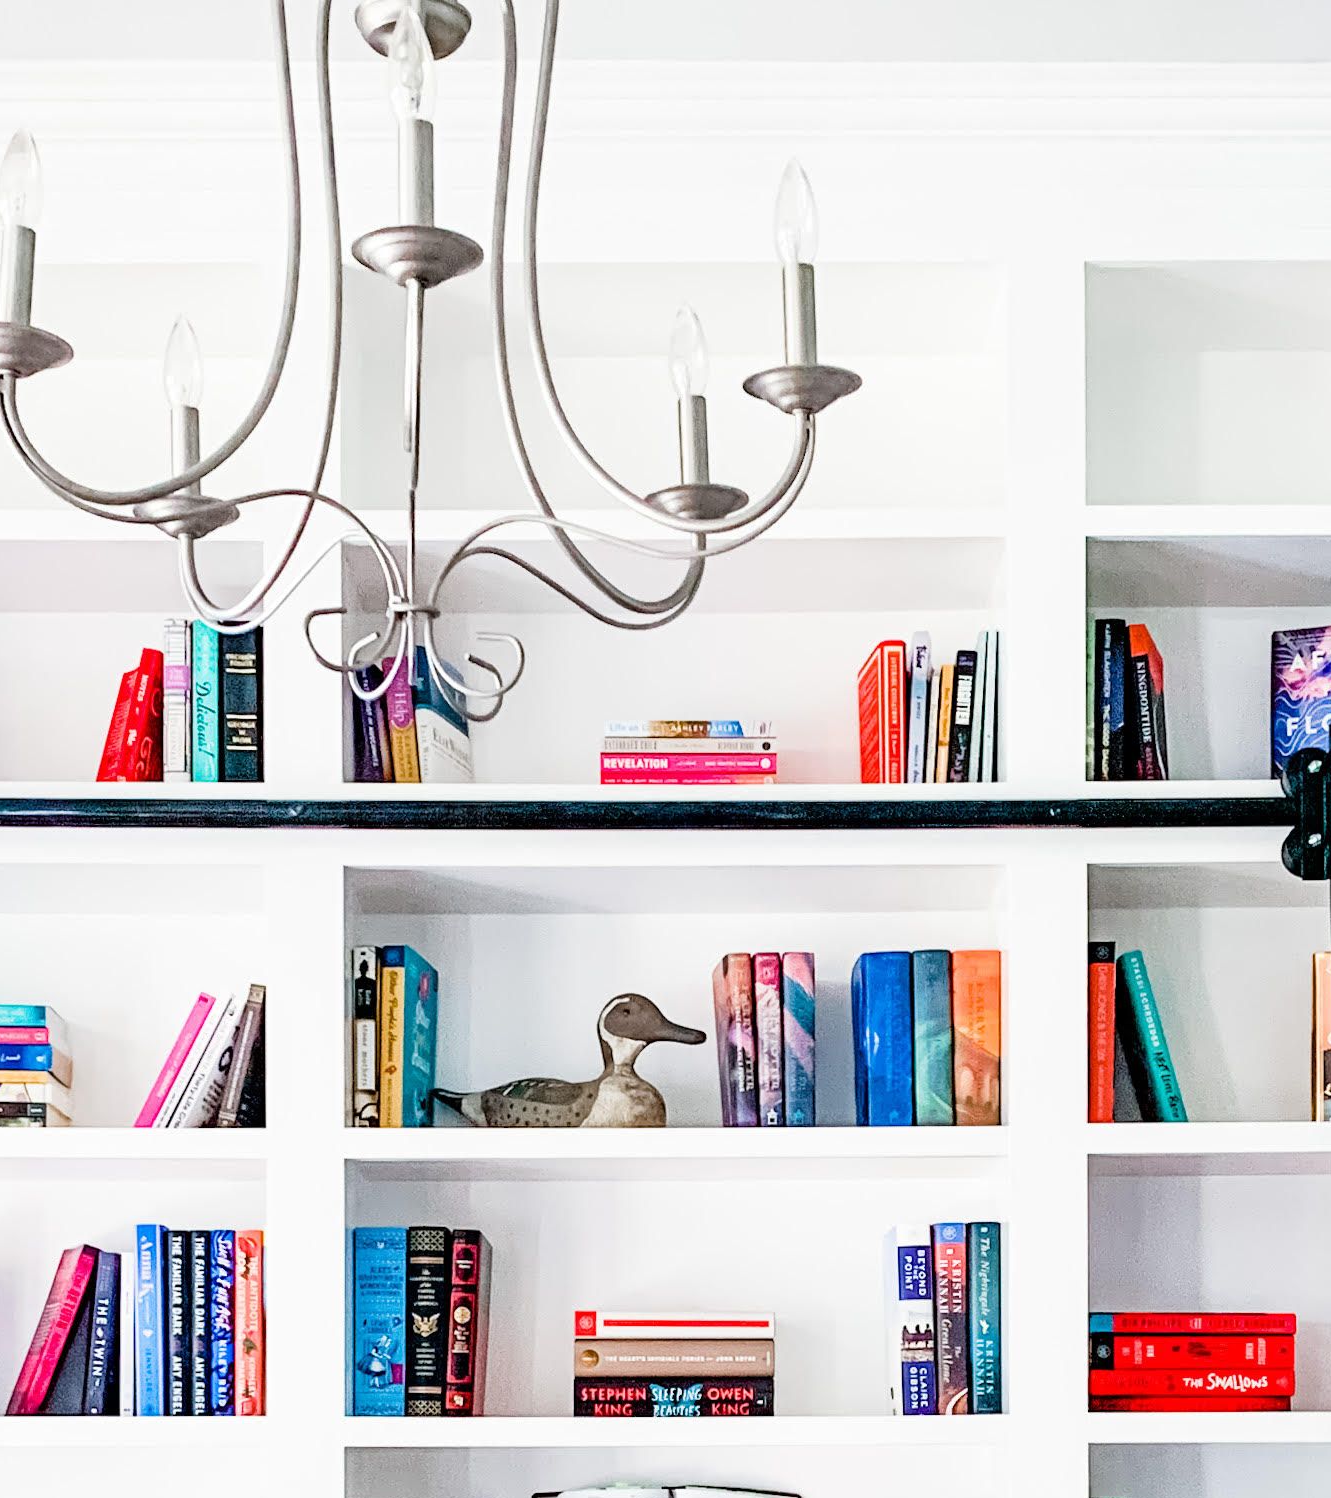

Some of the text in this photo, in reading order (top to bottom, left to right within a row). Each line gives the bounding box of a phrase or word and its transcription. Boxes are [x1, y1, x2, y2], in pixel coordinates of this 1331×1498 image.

[195, 681, 215, 756] Delicious!
[393, 693, 409, 722] Help
[1135, 662, 1152, 742] KINGDOMTIDE
[603, 757, 668, 769] REVELATION
[905, 1255, 915, 1290] POINT
[916, 1249, 927, 1296] BEYOND
[939, 1259, 949, 1314] HANNAH
[952, 1259, 962, 1313] KRISTIN
[979, 1238, 991, 1316] The Nightingale
[92, 1298, 109, 1377] THE TWIN
[193, 1236, 206, 1415] THE FAMILIAR DARK AMY ENGEL
[942, 1319, 953, 1383] Great Alone
[976, 1339, 986, 1397] HANNAH
[985, 1339, 994, 1394] KRISTIN
[580, 1387, 646, 1416] STEPHEN KING
[650, 1386, 702, 1416] SLEEPING BEAUTIES
[707, 1387, 754, 1416] OWEN KING
[909, 1367, 919, 1409] GIBSON
[919, 1368, 929, 1408] CLAIRE
[1183, 1373, 1268, 1390] THE SWALLOWS
